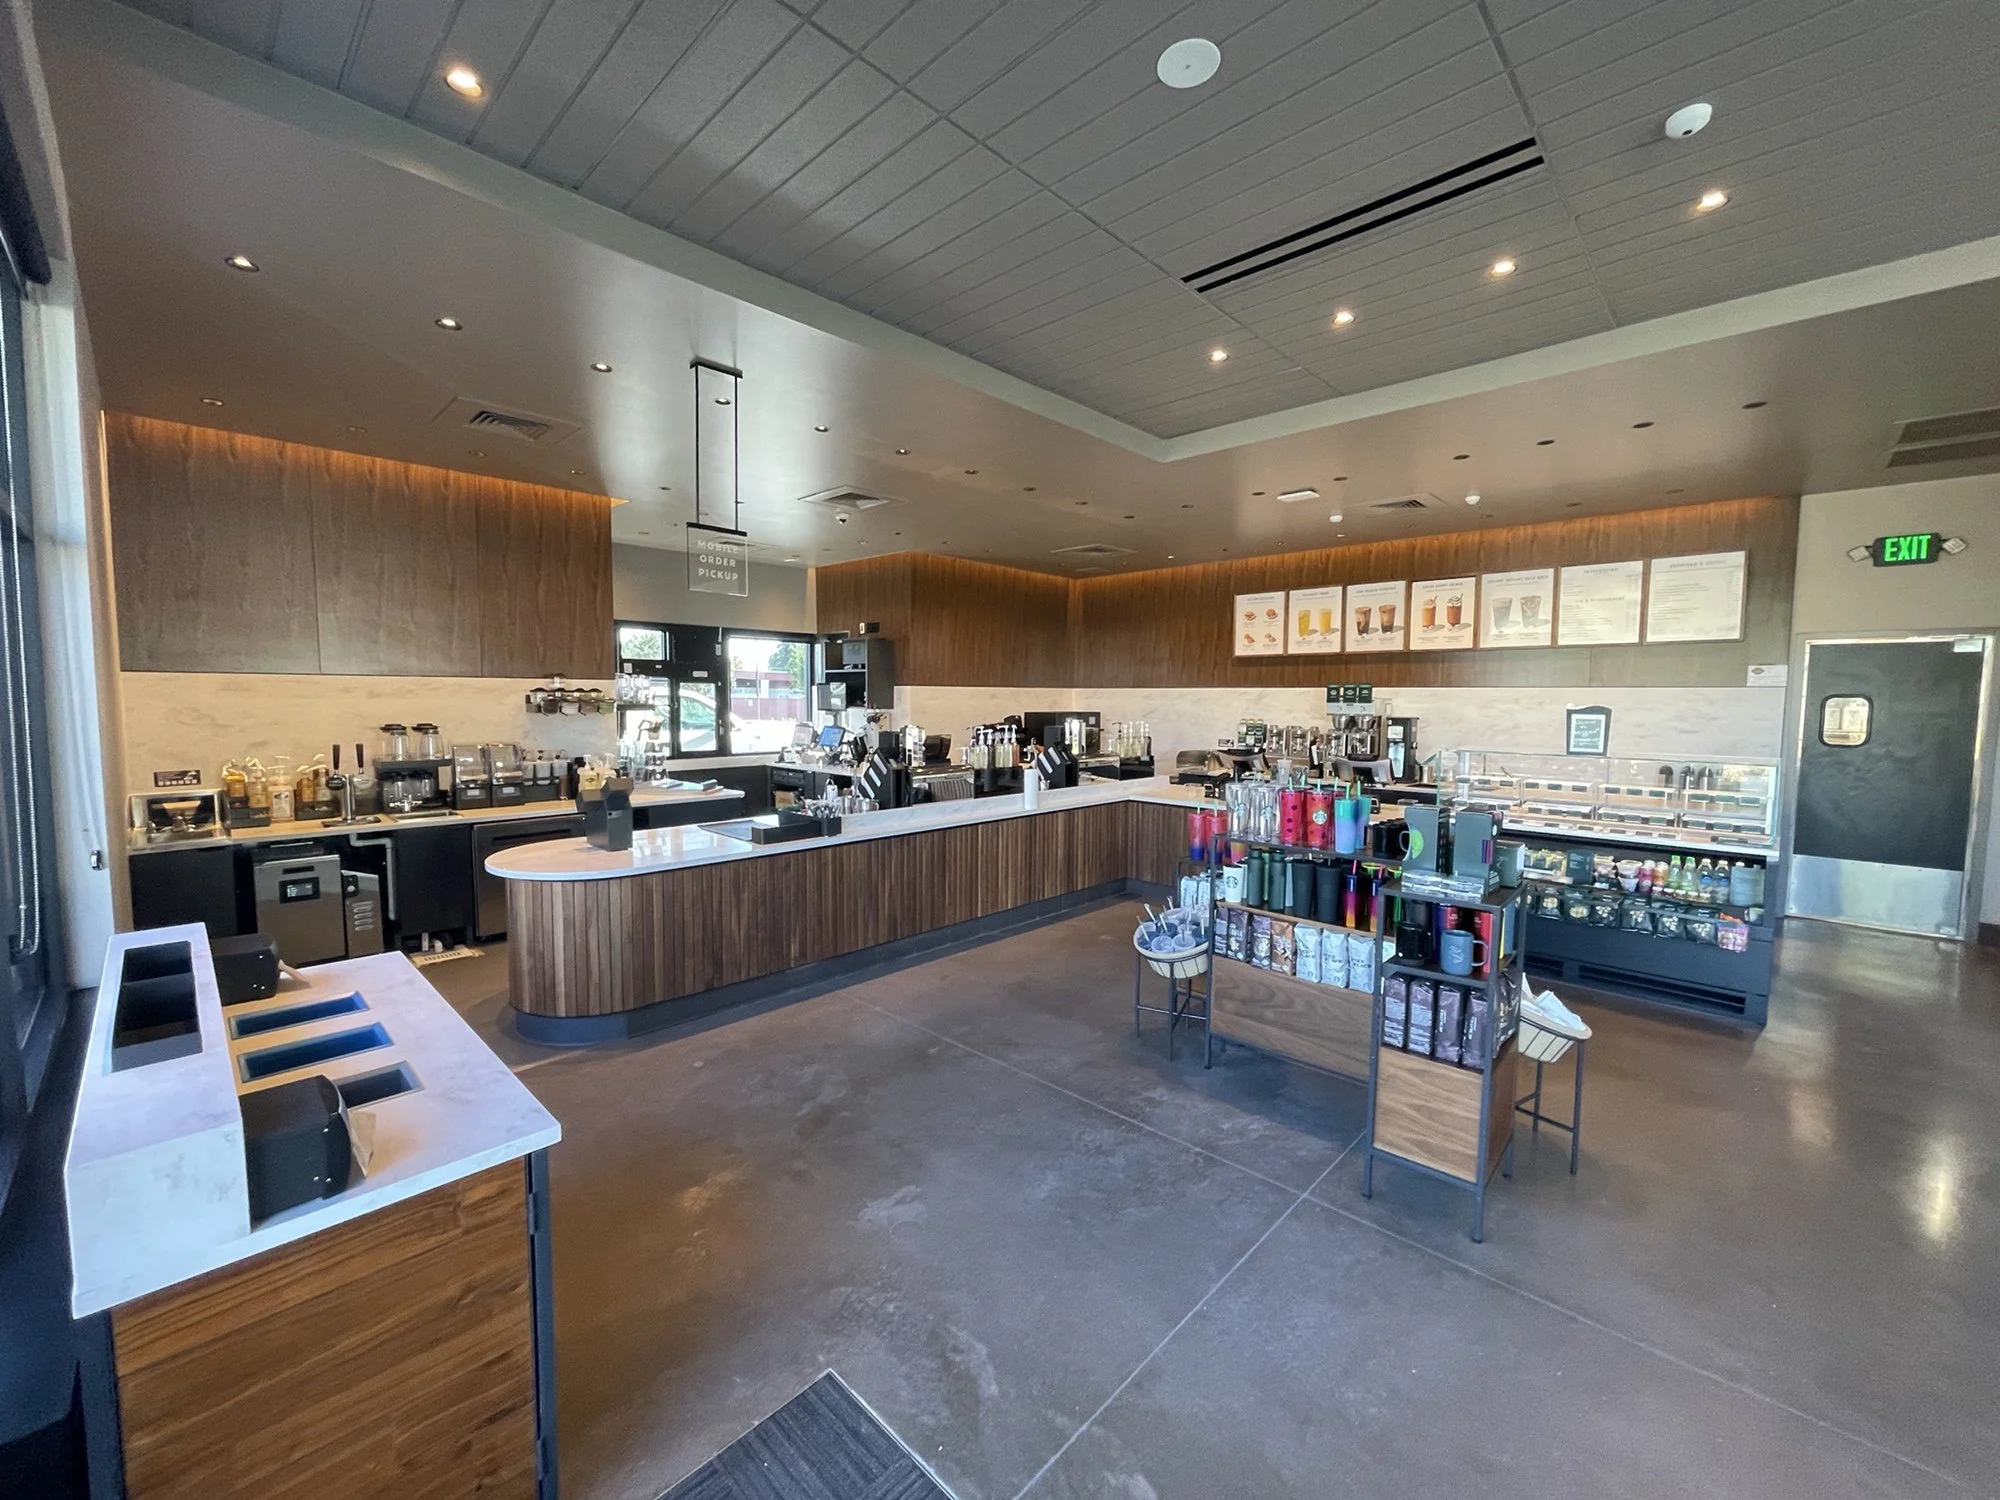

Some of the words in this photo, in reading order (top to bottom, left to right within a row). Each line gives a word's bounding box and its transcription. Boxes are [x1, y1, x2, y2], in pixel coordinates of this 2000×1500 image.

[697, 540, 738, 554] MOBILE
[1884, 535, 1932, 562] EXIT
[699, 555, 736, 567] ORDER
[698, 568, 738, 580] PICKUP
